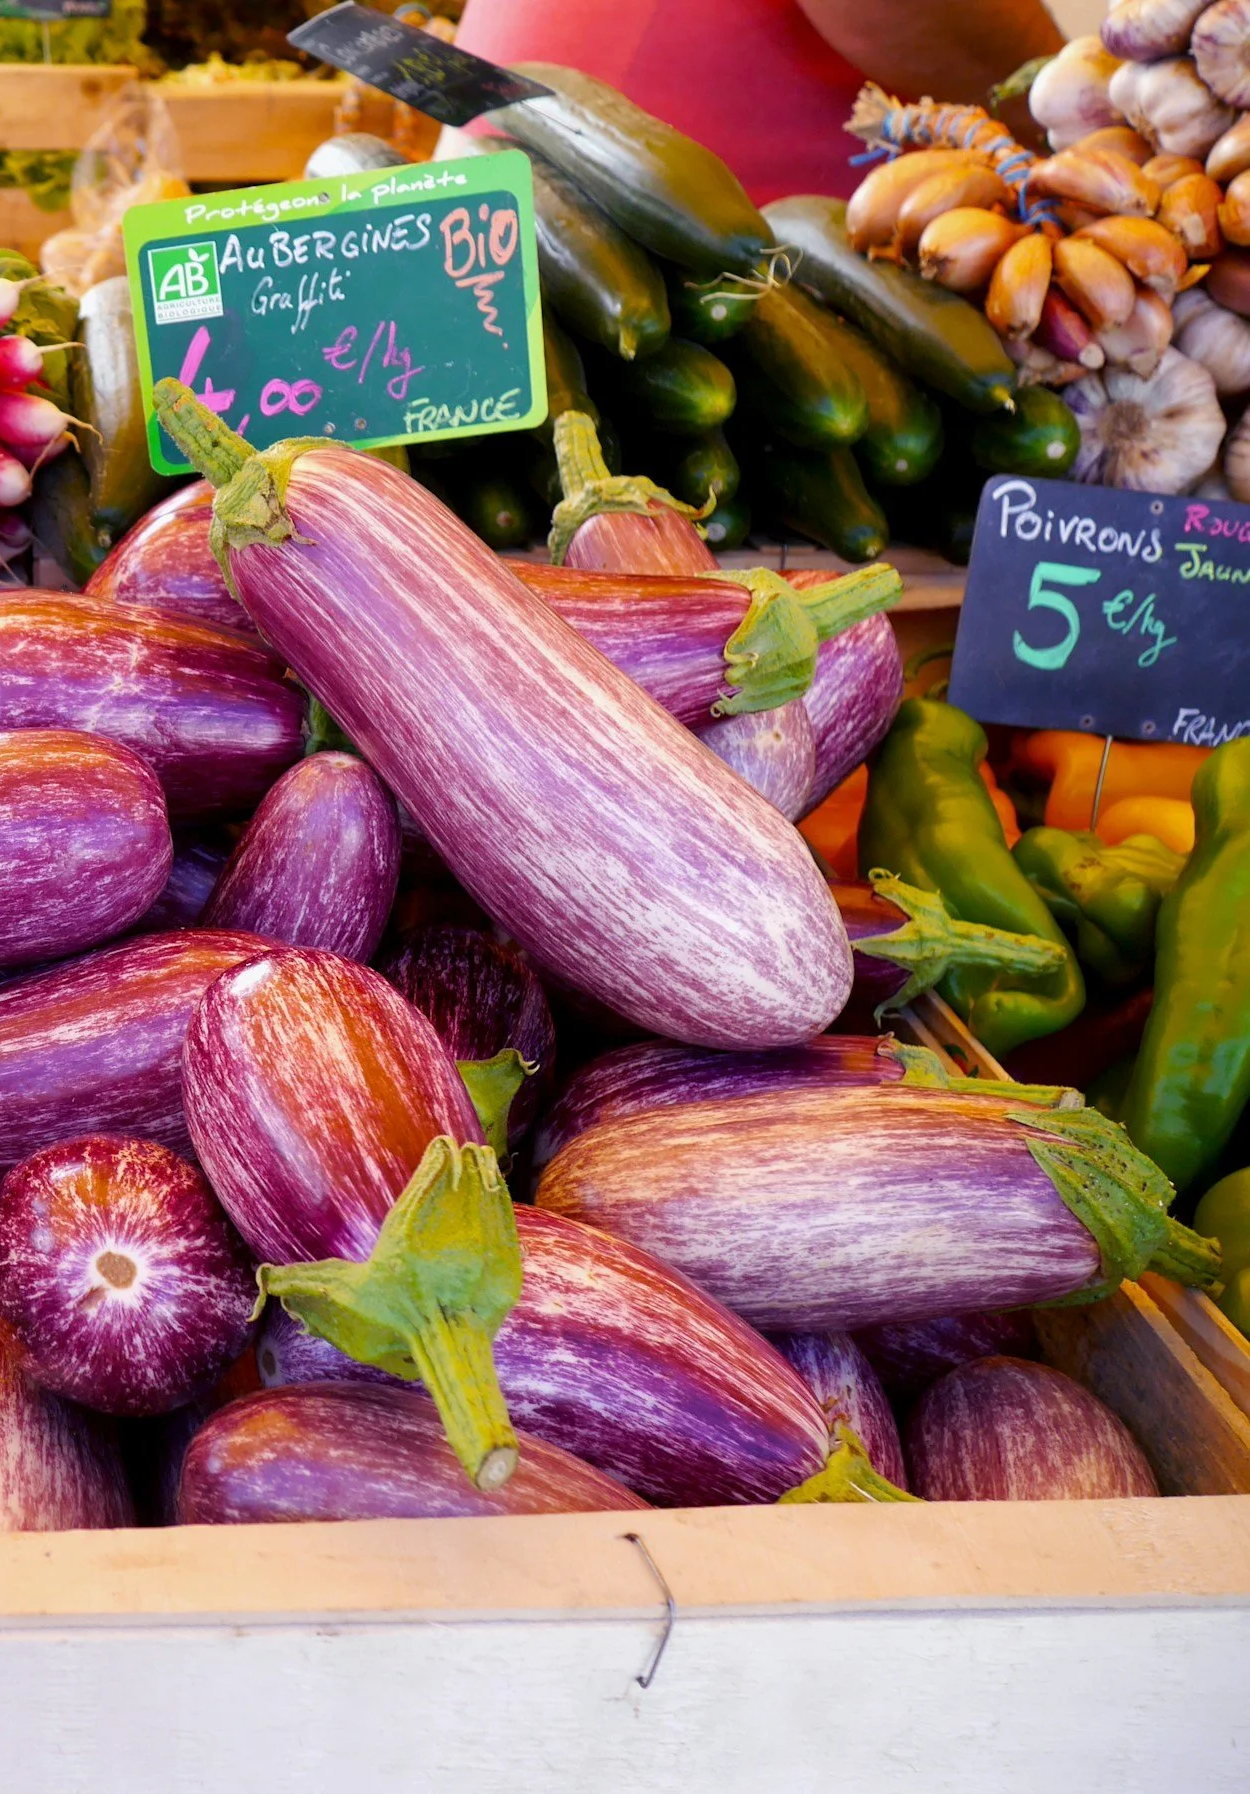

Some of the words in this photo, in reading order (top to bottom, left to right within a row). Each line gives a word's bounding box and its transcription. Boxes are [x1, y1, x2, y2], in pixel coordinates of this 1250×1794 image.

[340, 184, 363, 202] la
[370, 170, 468, 205] planète
[159, 261, 210, 301] AB
[251, 267, 351, 335] Graffiti
[157, 296, 222, 311] AGRICULTURE
[158, 305, 222, 319] BIOLOGIQUE
[403, 387, 522, 434] FRANCE
[1013, 561, 1101, 670] 5
